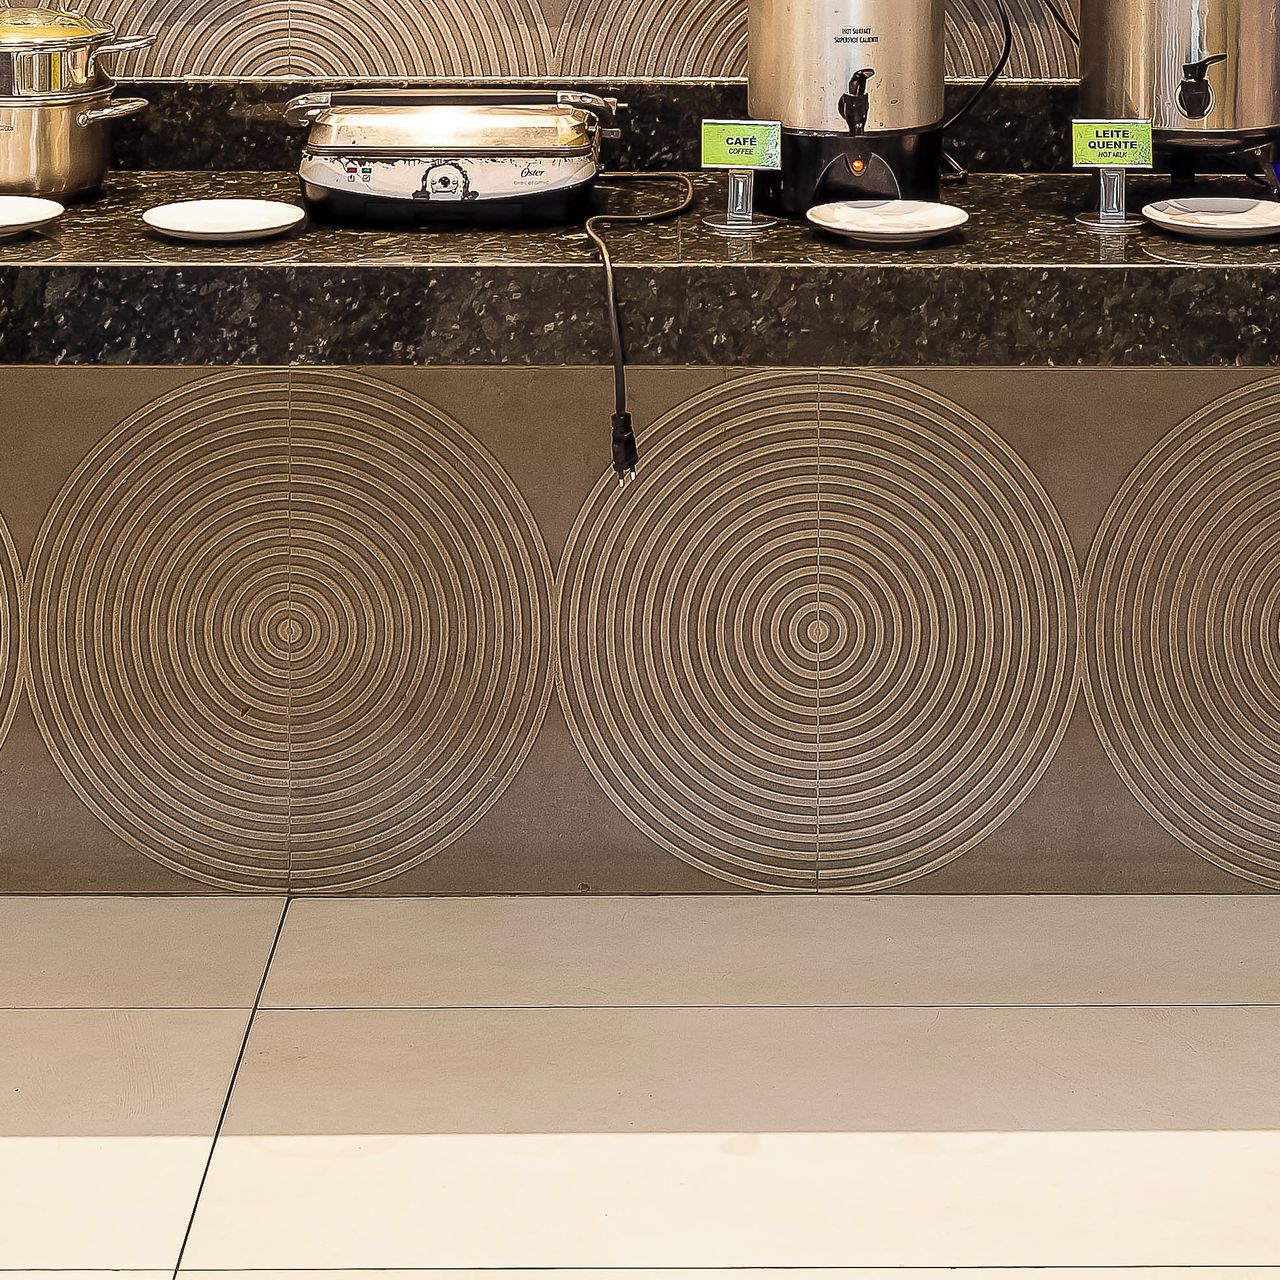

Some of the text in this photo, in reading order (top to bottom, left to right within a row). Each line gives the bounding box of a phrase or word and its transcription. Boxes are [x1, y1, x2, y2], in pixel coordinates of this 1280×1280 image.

[1095, 130, 1129, 138] LEITE
[726, 136, 757, 146] CAFÉ
[1088, 141, 1137, 149] QUENTE
